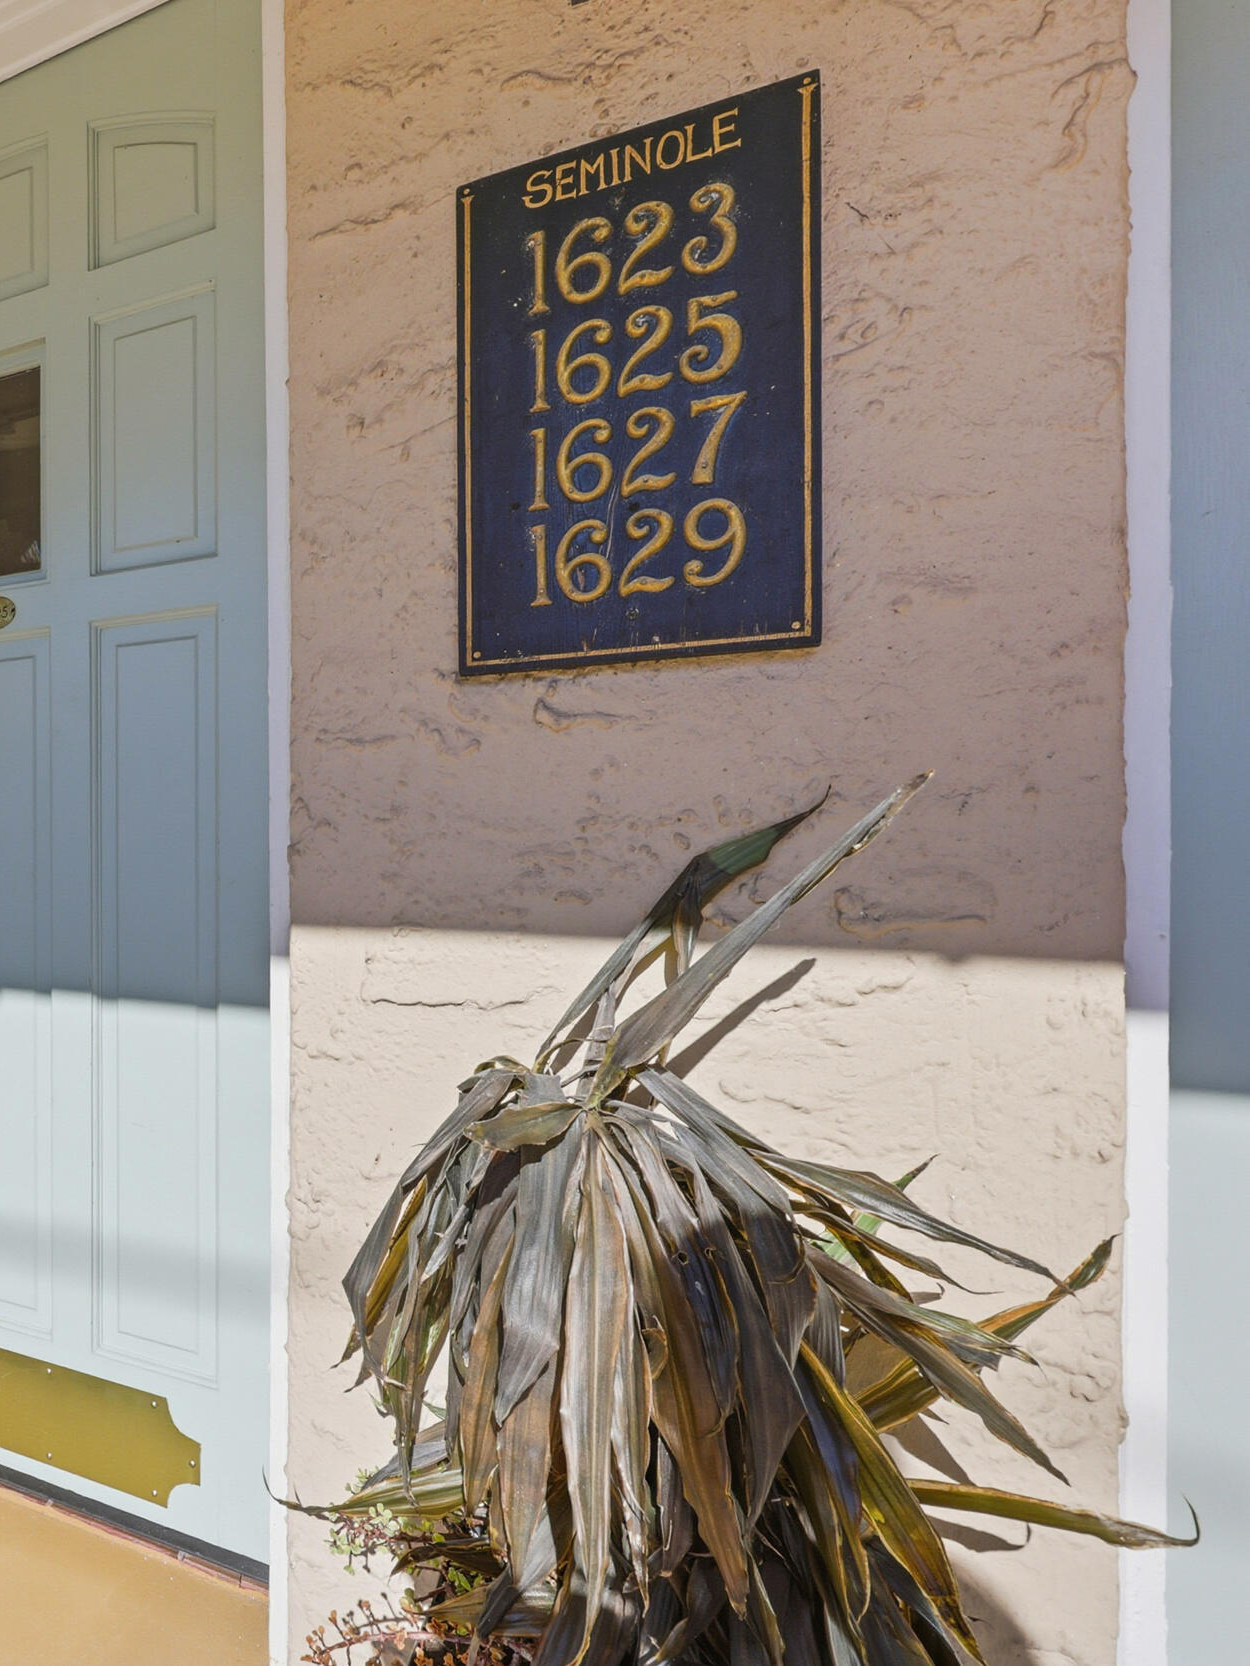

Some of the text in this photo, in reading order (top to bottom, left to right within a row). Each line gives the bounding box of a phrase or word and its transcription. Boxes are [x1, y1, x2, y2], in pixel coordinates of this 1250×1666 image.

[523, 108, 741, 208] SEMINOLE
[525, 182, 738, 316] 1623
[528, 290, 744, 413] 1625
[527, 391, 748, 512] 1627
[528, 498, 748, 607] 1629
